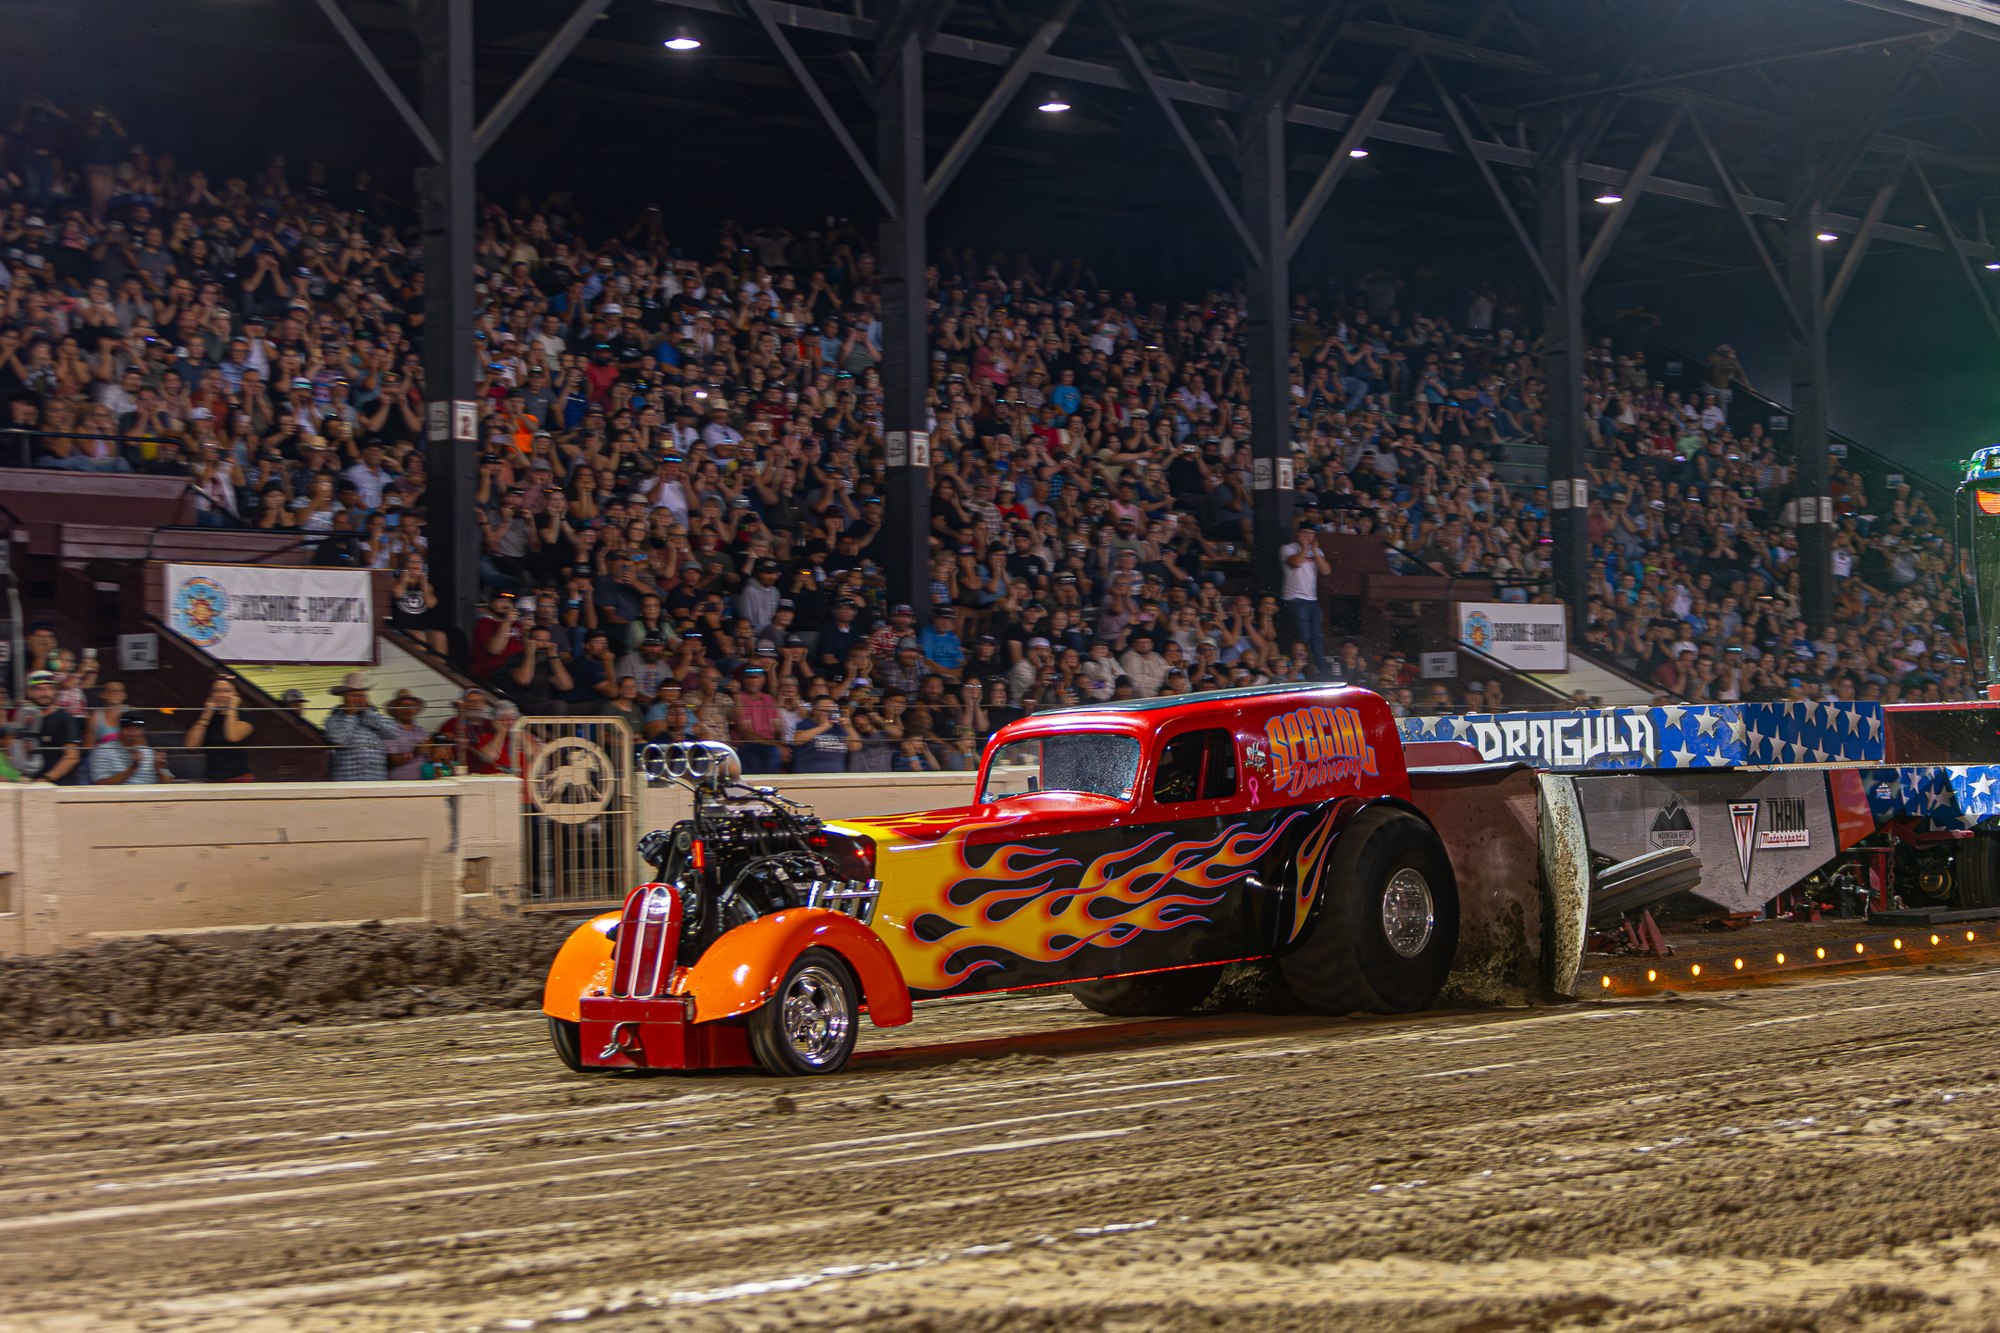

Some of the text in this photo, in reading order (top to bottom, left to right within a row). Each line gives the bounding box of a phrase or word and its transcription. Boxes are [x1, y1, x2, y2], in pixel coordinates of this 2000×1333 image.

[1264, 705, 1380, 791] SPECIAL
[1472, 715, 1655, 766] DRAGULA
[1287, 757, 1365, 797] Delivery
[1766, 797, 1806, 832] THAIN
[1657, 831, 1690, 840] MOUNTAIN WEST
[1662, 839, 1673, 847] AUTO
[1762, 833, 1807, 847] Motorsports
